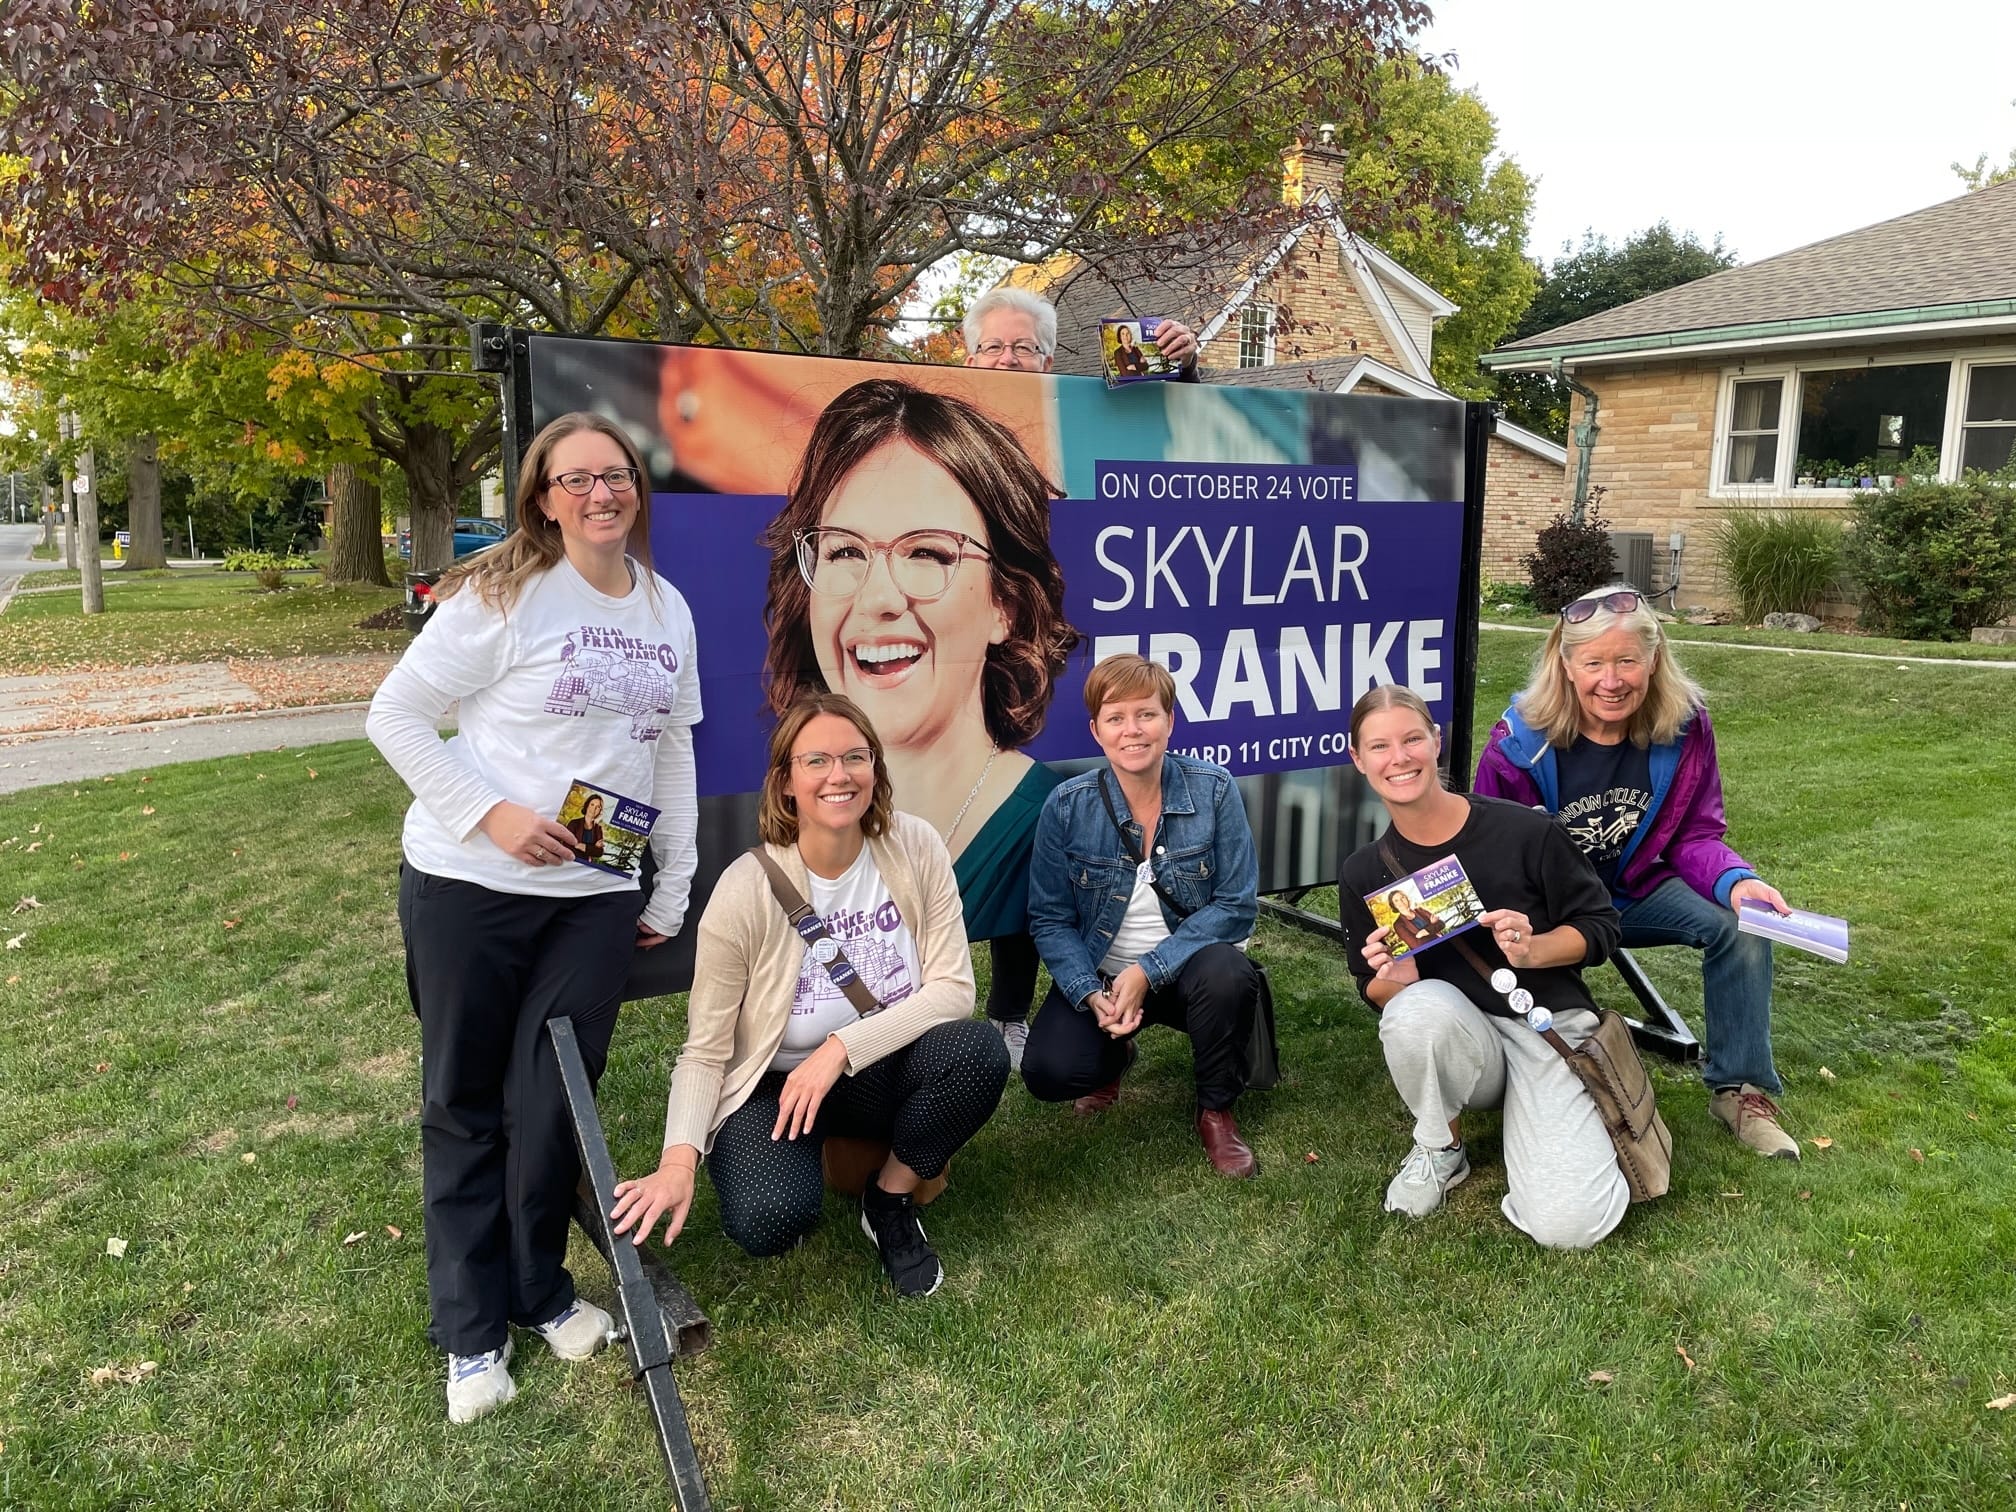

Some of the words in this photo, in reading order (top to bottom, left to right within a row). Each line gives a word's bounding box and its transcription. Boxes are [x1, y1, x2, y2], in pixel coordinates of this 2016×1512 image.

[1101, 472, 1140, 499] ON
[1148, 473, 1259, 500] OCTOBER
[1266, 475, 1292, 500] 24
[1298, 476, 1353, 500] VOTE
[1092, 525, 1370, 612] SKYLAR
[580, 625, 624, 637] SKYLAR
[582, 634, 644, 650] FRANKE
[624, 649, 657, 661] WARD
[1165, 744, 1232, 767] ARD
[1238, 741, 1260, 764] 11
[1268, 735, 1314, 761] CITY
[624, 805, 649, 820] SKYLAR
[1558, 793, 1602, 826] NDON
[1602, 787, 1641, 807] CYCLE
[618, 811, 651, 829] FRANKE
[1423, 865, 1450, 882] SKYLAR
[1423, 869, 1459, 891] FRANKE
[826, 910, 865, 936] ANKE
[845, 919, 876, 940] WARD
